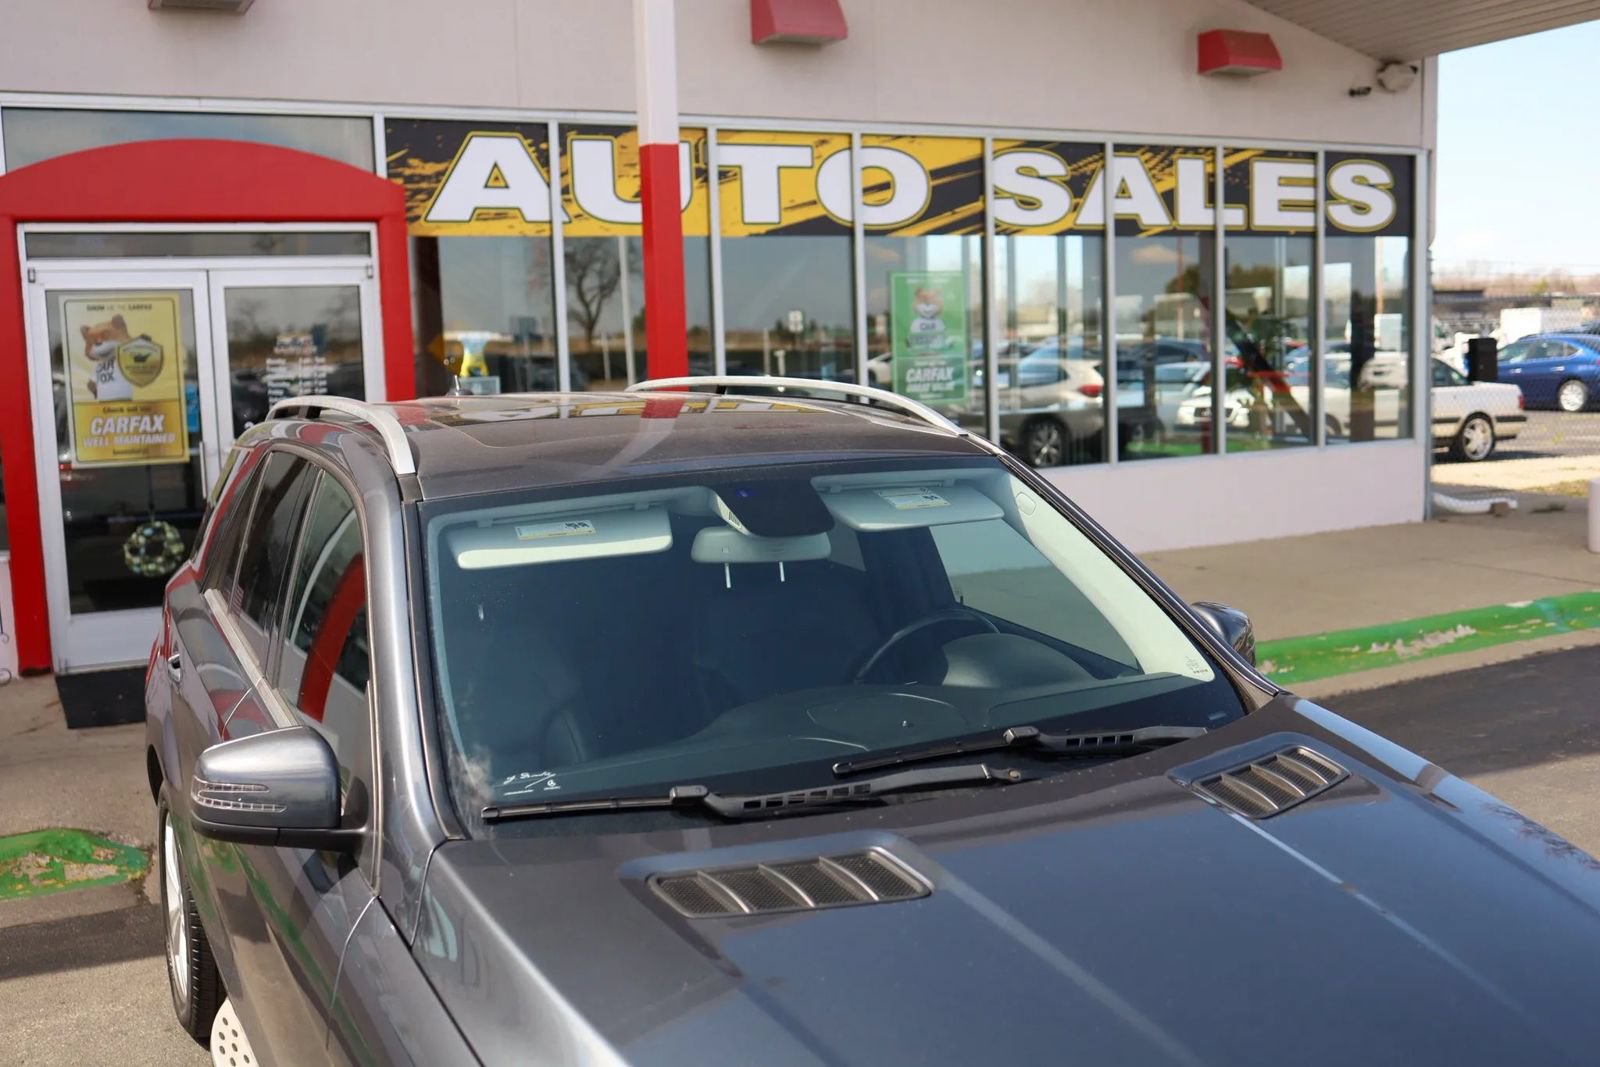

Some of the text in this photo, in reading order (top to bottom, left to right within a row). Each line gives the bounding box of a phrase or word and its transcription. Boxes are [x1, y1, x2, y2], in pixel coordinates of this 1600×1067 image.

[424, 132, 1397, 232] AUTO SALES
[905, 367, 954, 383] CARFAX
[91, 414, 165, 436] CARFAX
